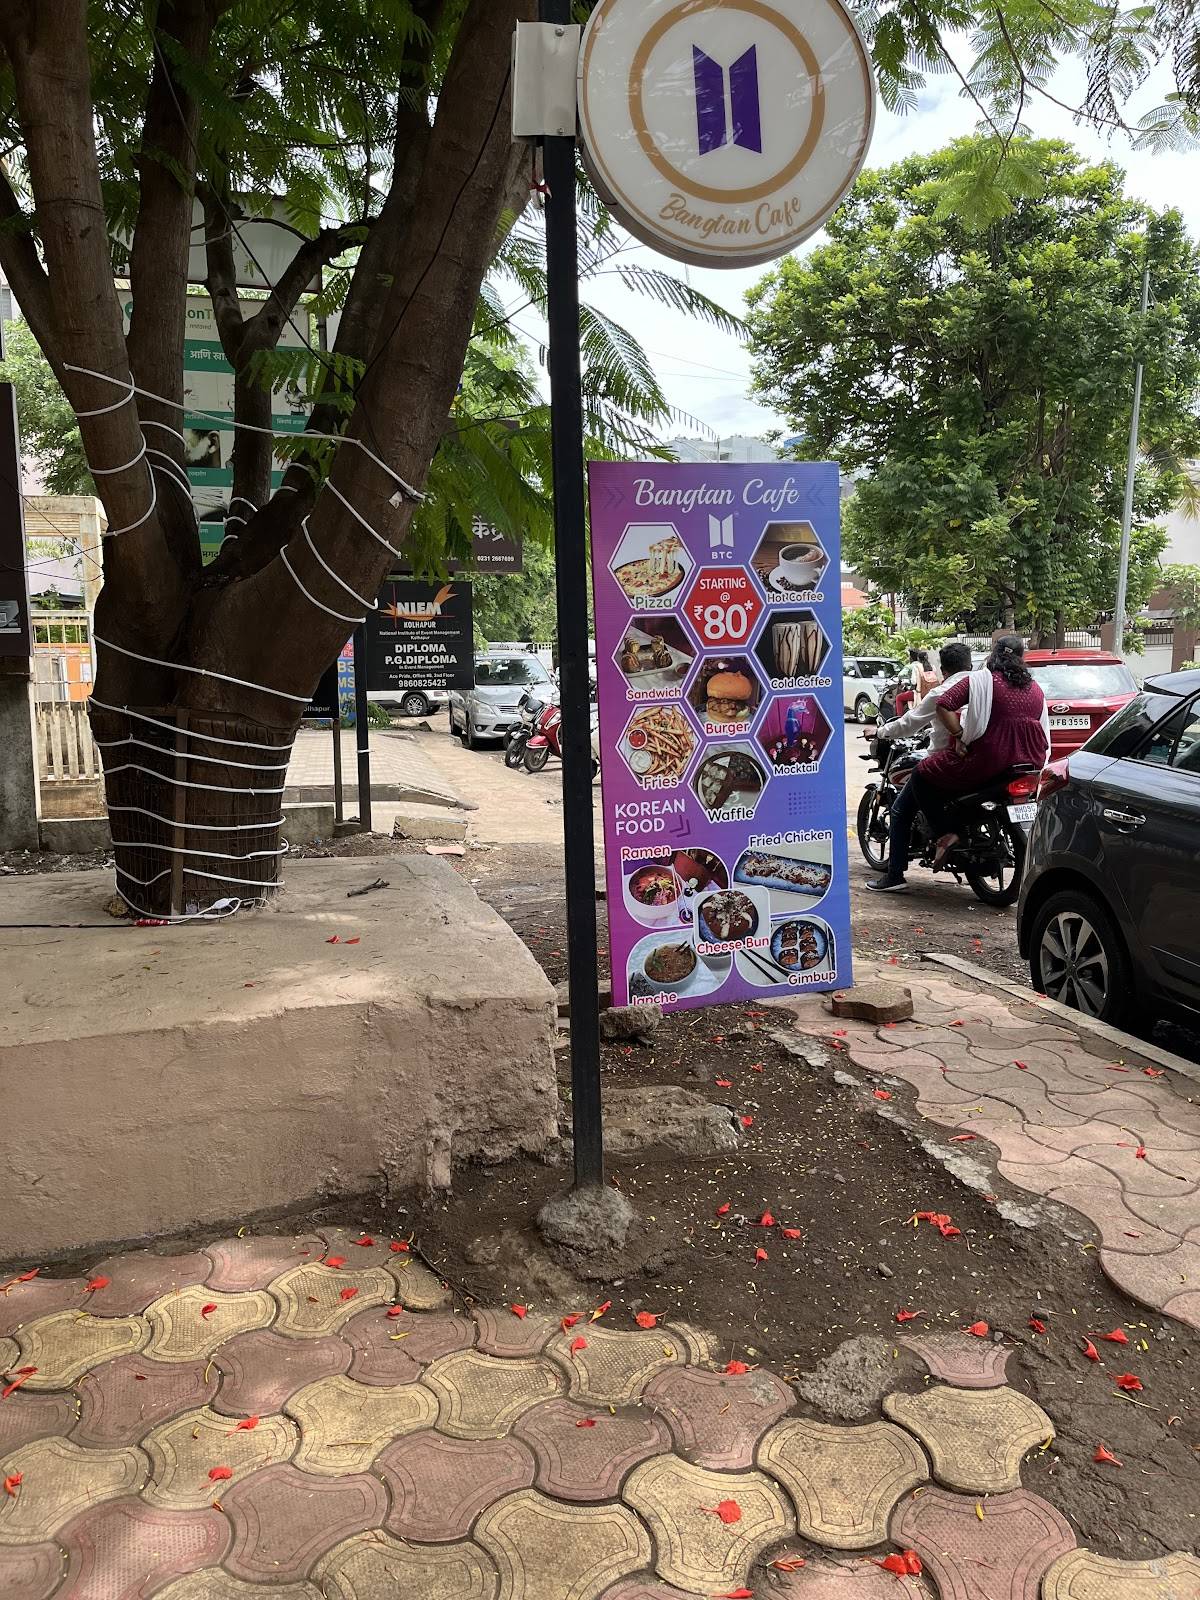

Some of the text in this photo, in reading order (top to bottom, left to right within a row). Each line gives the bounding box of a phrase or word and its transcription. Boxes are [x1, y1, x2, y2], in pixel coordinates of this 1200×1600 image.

[658, 192, 802, 239] Bangtan Cafe
[633, 477, 800, 513] Bangtan Cafe
[711, 551, 733, 560] BTC
[699, 577, 746, 590] STARTING
[635, 596, 673, 610] Pizza
[720, 592, 731, 602] @
[767, 591, 823, 603] Hot Coffee
[396, 601, 442, 616] NIEM
[403, 621, 436, 629] KOLHAPUR
[395, 644, 447, 653] DIPLOMA
[385, 655, 457, 664] P.G.DIPLOMA
[398, 679, 447, 687] 9860825425
[771, 676, 832, 689] Cold Coffee
[627, 687, 681, 700] Sandwich
[304, 705, 332, 713] olhapur.
[1068, 718, 1089, 726] 3556
[706, 723, 750, 738] Burger
[774, 763, 818, 775] Mocktail
[643, 776, 678, 789] Fries
[615, 799, 686, 819] KOREAN
[708, 808, 754, 822] Waffle
[615, 818, 665, 836] FOOD
[750, 830, 832, 848] Fried Chicken
[622, 845, 671, 860] Ramen
[697, 937, 769, 954] Cheese Bun
[788, 971, 836, 986] Gimbup
